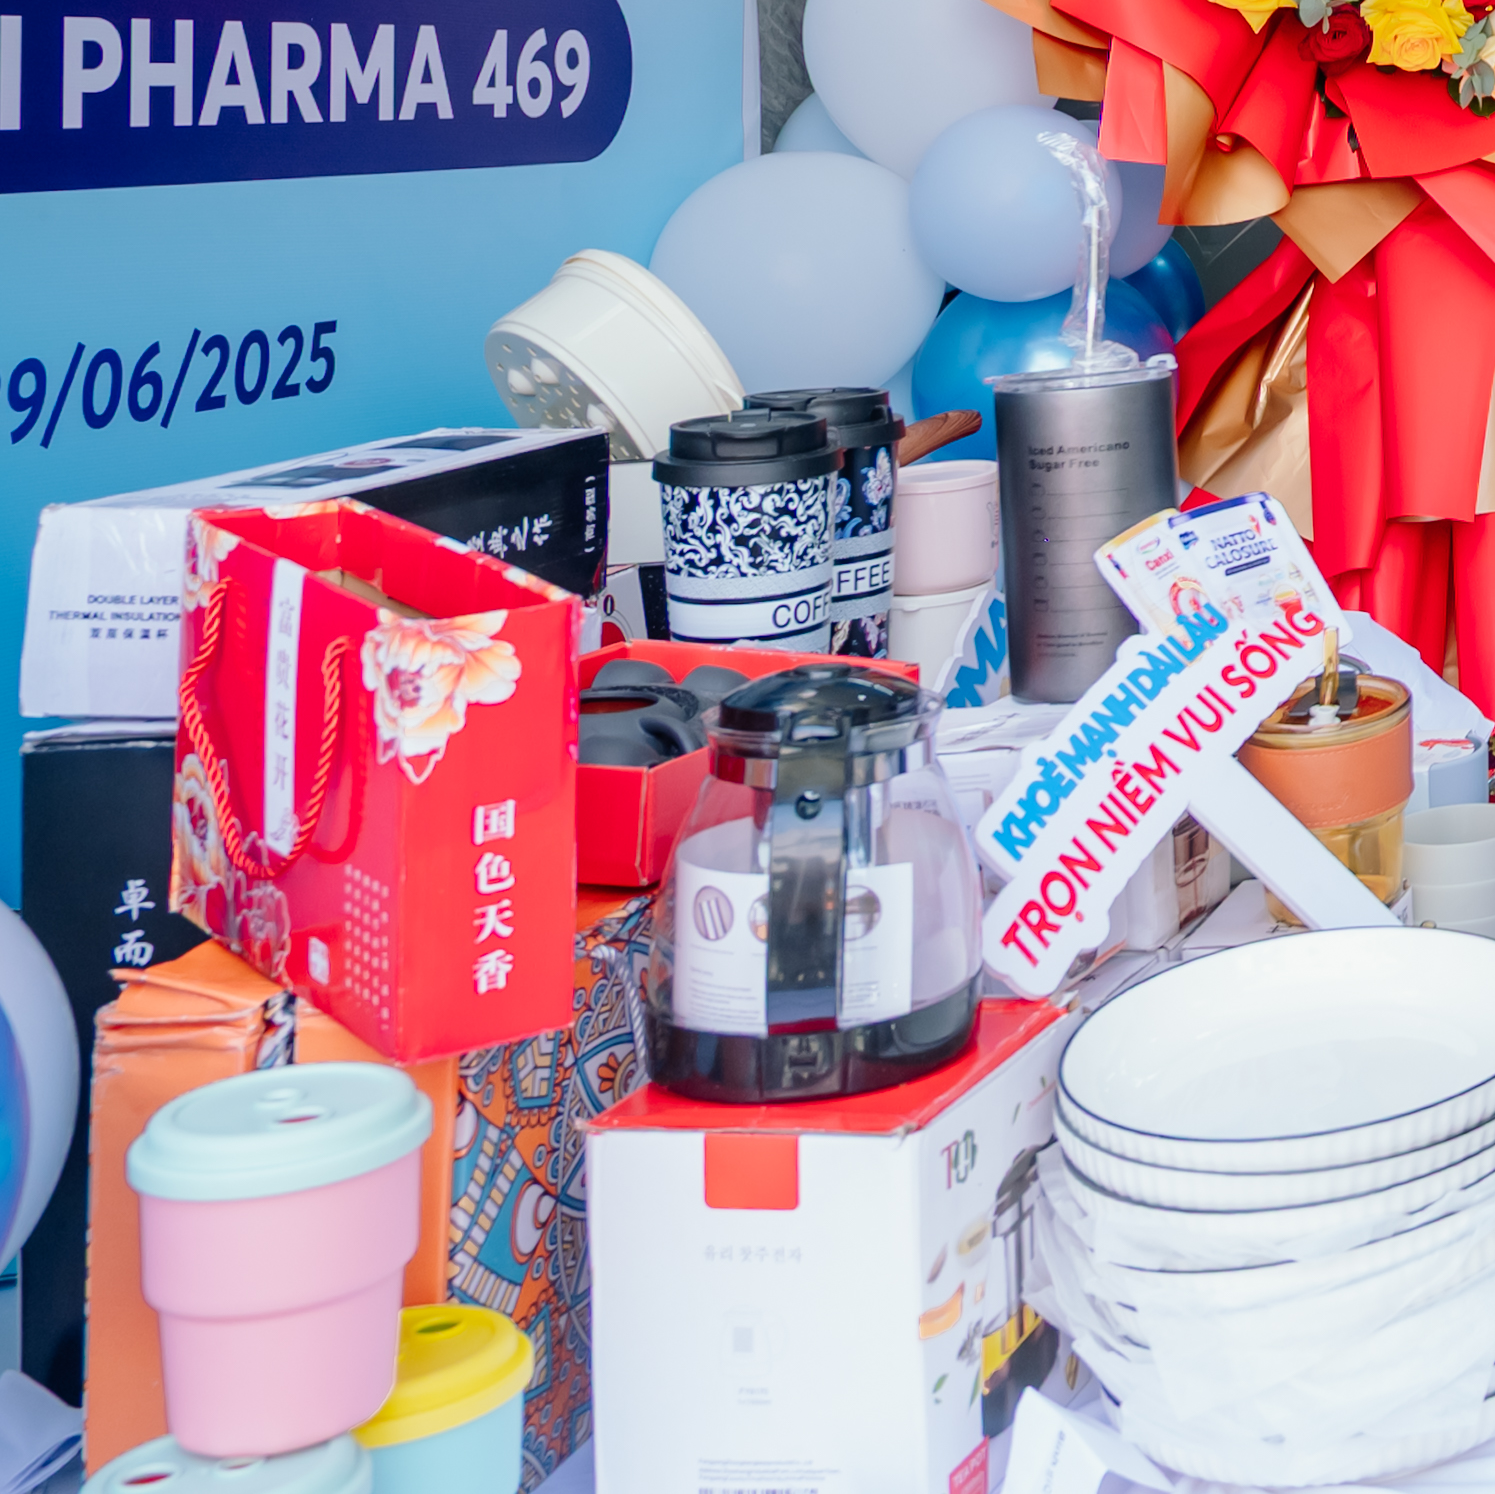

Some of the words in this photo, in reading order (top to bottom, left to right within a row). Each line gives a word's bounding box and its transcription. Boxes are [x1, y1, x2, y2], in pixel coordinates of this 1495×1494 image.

[62, 15, 453, 130] PHARMA
[472, 27, 590, 119] 469
[6, 319, 338, 450] 9/06/2025
[1028, 444, 1054, 457] Iced
[1056, 440, 1131, 455] Americano
[1028, 458, 1066, 473] Sugar
[1069, 458, 1100, 468] Free
[1209, 528, 1257, 552] NATTO
[87, 594, 137, 605] DOUBLE
[140, 594, 179, 605] LAYER
[837, 560, 891, 594] FFEE
[49, 610, 107, 621] THERMAL
[1054, 682, 1146, 780] MẠNH
[1126, 644, 1187, 701] DÀI
[1166, 602, 1229, 662] LÂU
[1000, 836, 1104, 968] TRỌN
[1085, 742, 1182, 854] NIỀM
[1161, 684, 1237, 753] VUI
[1220, 599, 1325, 699] SỐNG
[113, 878, 157, 967] 卓而
[472, 798, 516, 996] 国色天香
